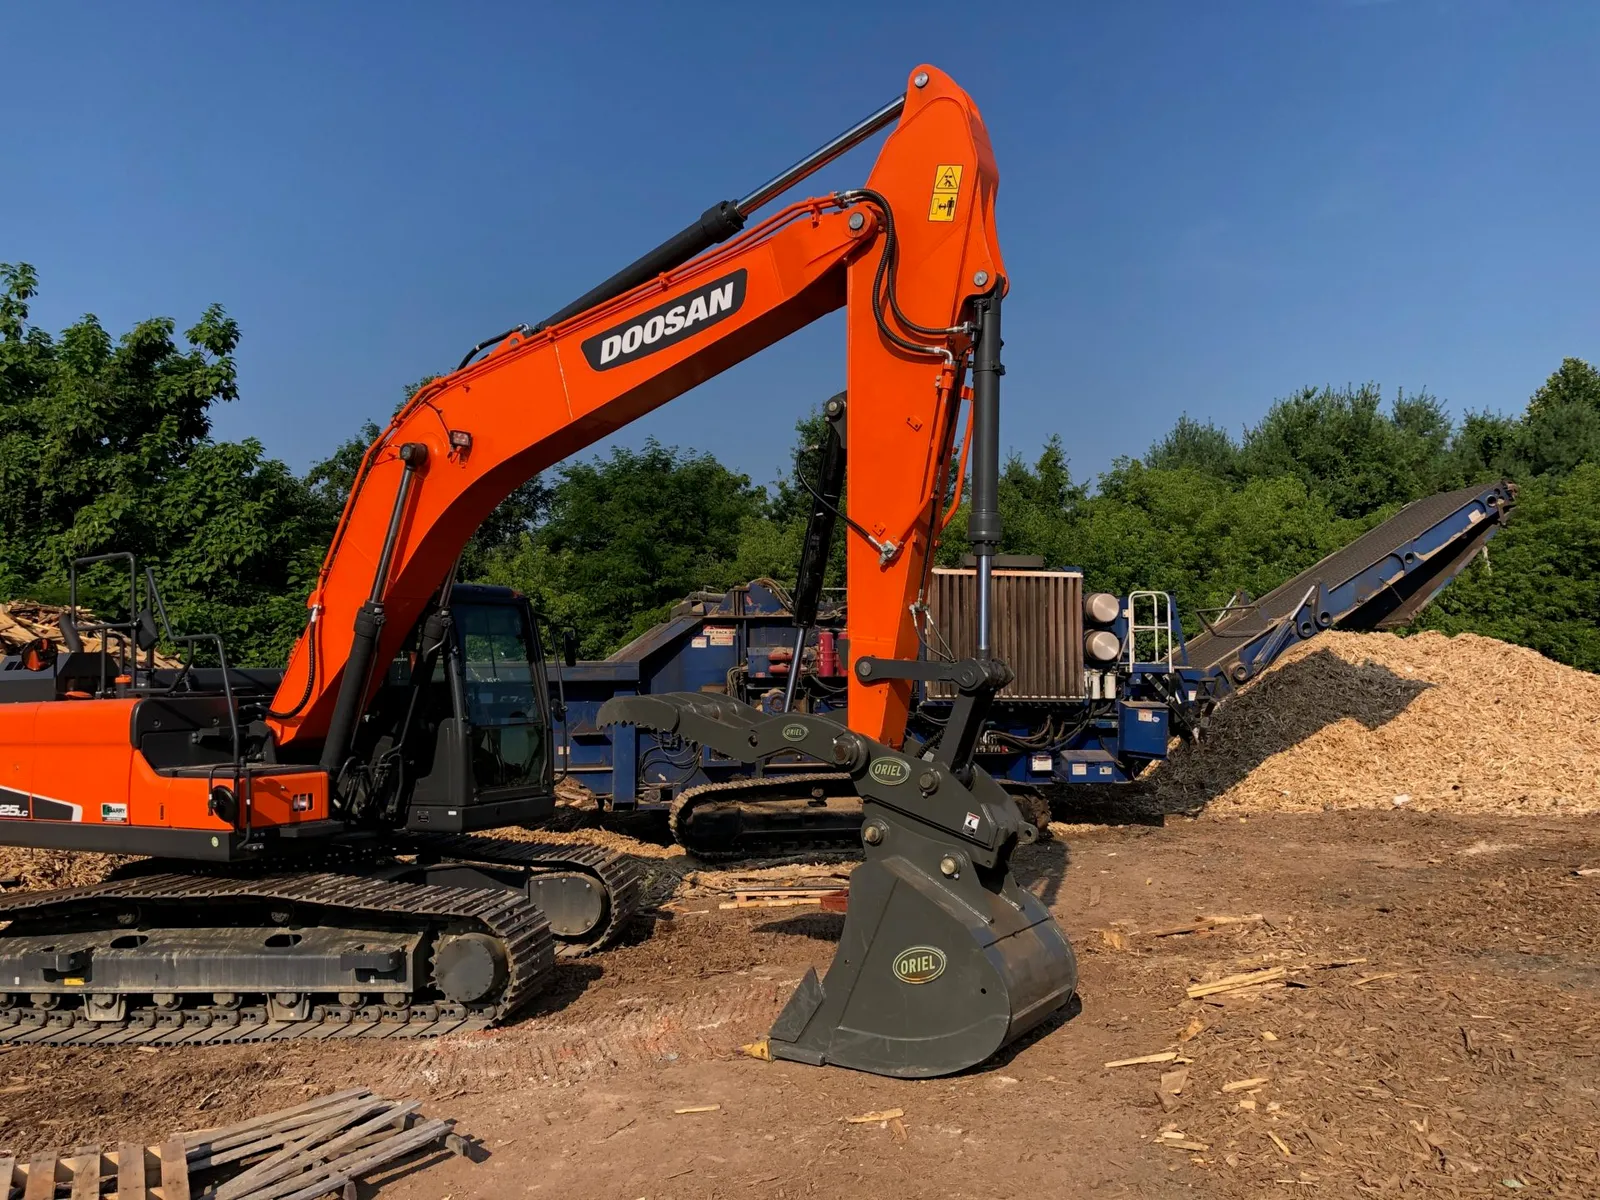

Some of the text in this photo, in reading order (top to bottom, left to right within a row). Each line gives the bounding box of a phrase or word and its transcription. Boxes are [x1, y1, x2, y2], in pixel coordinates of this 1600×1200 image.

[600, 281, 734, 365] DOOSAN
[786, 728, 802, 736] ORIEL
[874, 763, 901, 777] ORIEL
[900, 955, 936, 975] ORIEL
